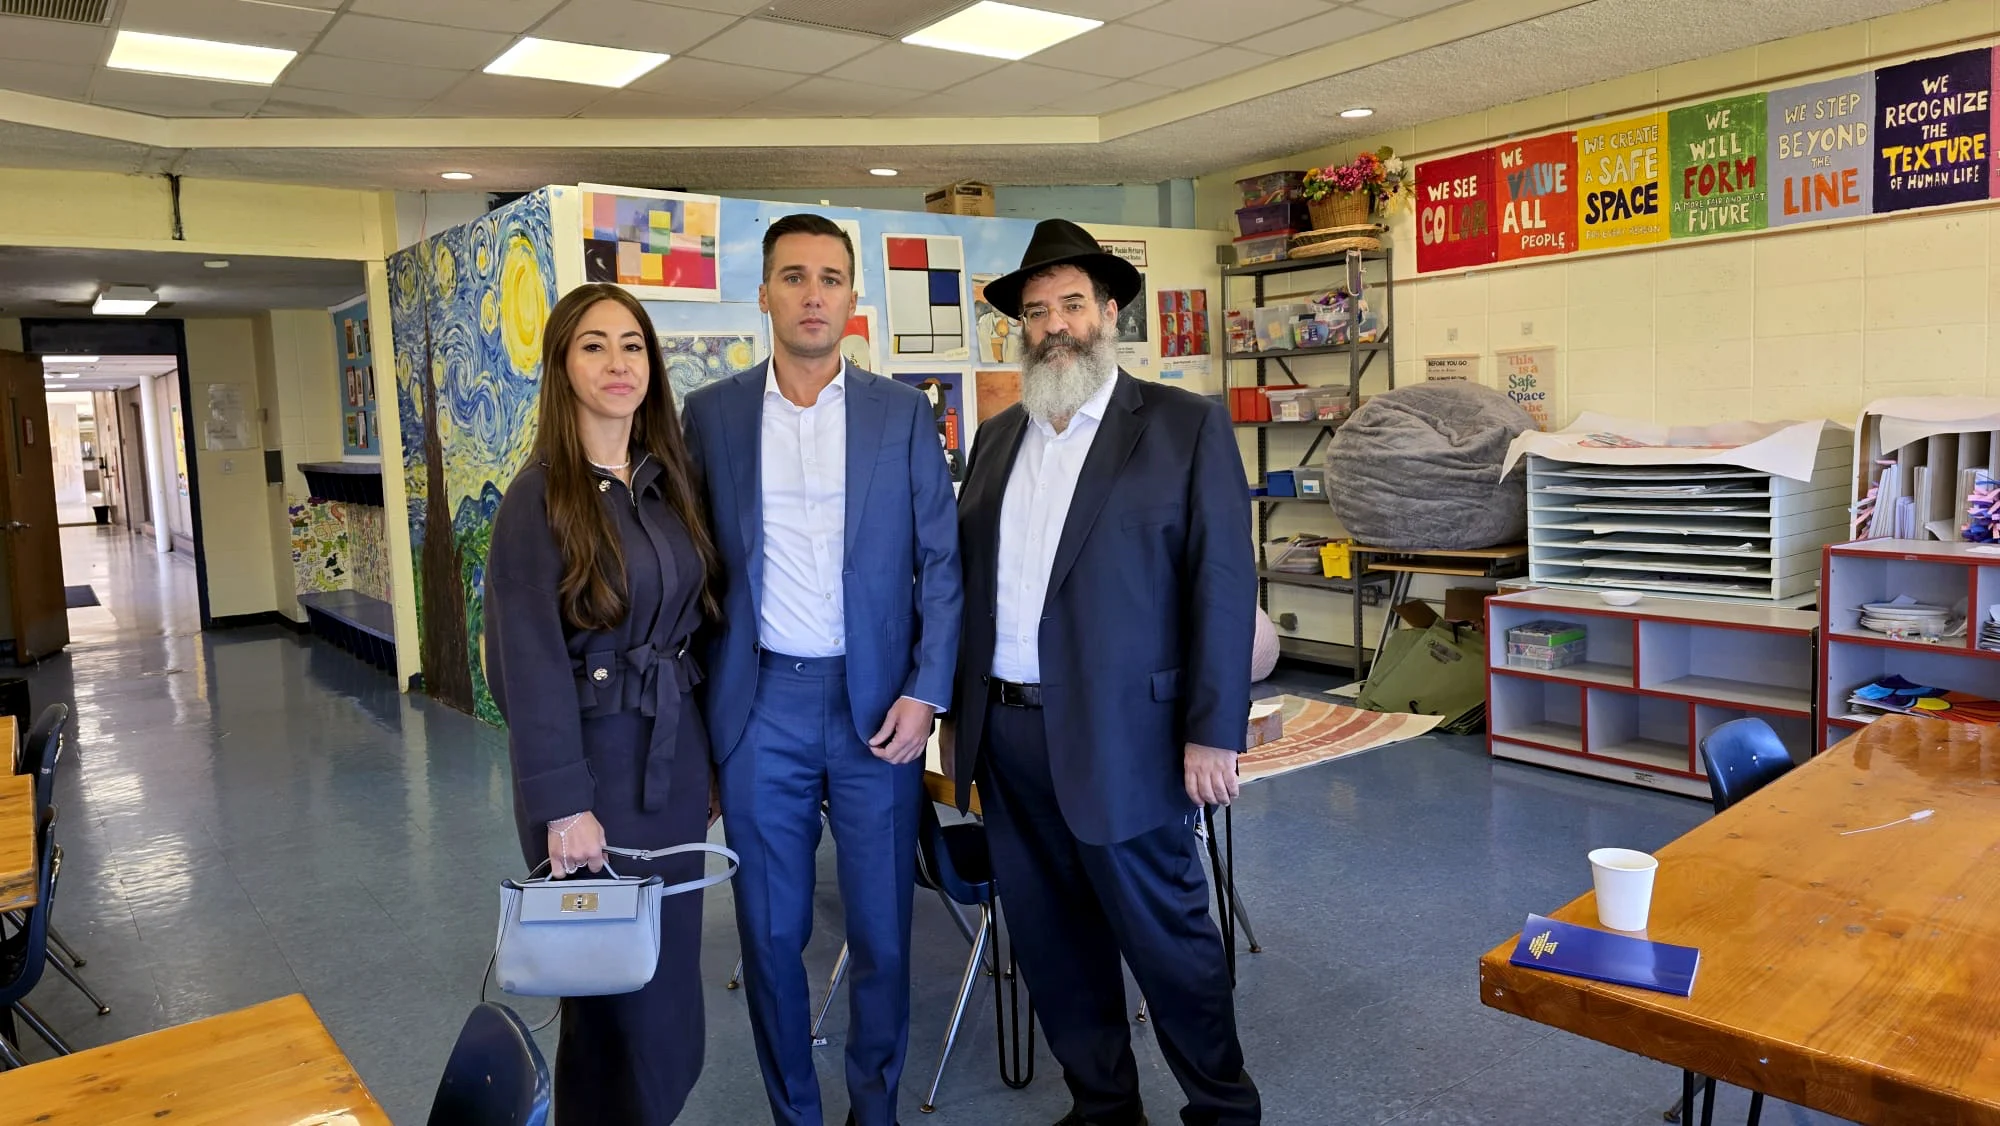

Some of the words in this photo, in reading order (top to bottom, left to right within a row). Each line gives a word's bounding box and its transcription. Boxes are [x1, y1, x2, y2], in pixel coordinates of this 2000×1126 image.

[1921, 74, 1949, 95] WE
[1705, 109, 1731, 131] WE
[1784, 103, 1807, 125] WE
[1815, 93, 1860, 120] STEP
[1885, 90, 1988, 129] RECOGNIZE
[1584, 135, 1605, 155] WE
[1610, 124, 1659, 149] CREATE
[1778, 122, 1869, 160] BEYOND
[1921, 122, 1948, 140] THE
[1501, 147, 1524, 169] WE
[1689, 132, 1742, 161] WILL
[1881, 133, 1987, 177] TEXTURE
[1584, 168, 1593, 183] A
[1598, 147, 1658, 186] SAFE
[1684, 153, 1757, 200] FORM
[1811, 155, 1831, 169] THE
[1427, 181, 1450, 202] WE
[1453, 175, 1477, 199] SEE
[1507, 162, 1568, 202] VALUE
[1890, 176, 1903, 190] OF
[1907, 172, 1949, 190] HUMAN
[1953, 164, 1980, 184] LIFE
[1584, 181, 1659, 225] SPACE
[1674, 202, 1681, 213] A
[1683, 200, 1704, 211] MORE
[1745, 192, 1765, 202] JUST
[1783, 168, 1860, 216] LINE
[1421, 200, 1489, 246] COLOR
[1502, 199, 1547, 234] ALL
[1688, 202, 1750, 232] FUTURE
[1521, 232, 1566, 250] PEOPLE
[1508, 354, 1534, 366] This
[1507, 390, 1546, 403] Space
[1508, 373, 1537, 392] Safe
